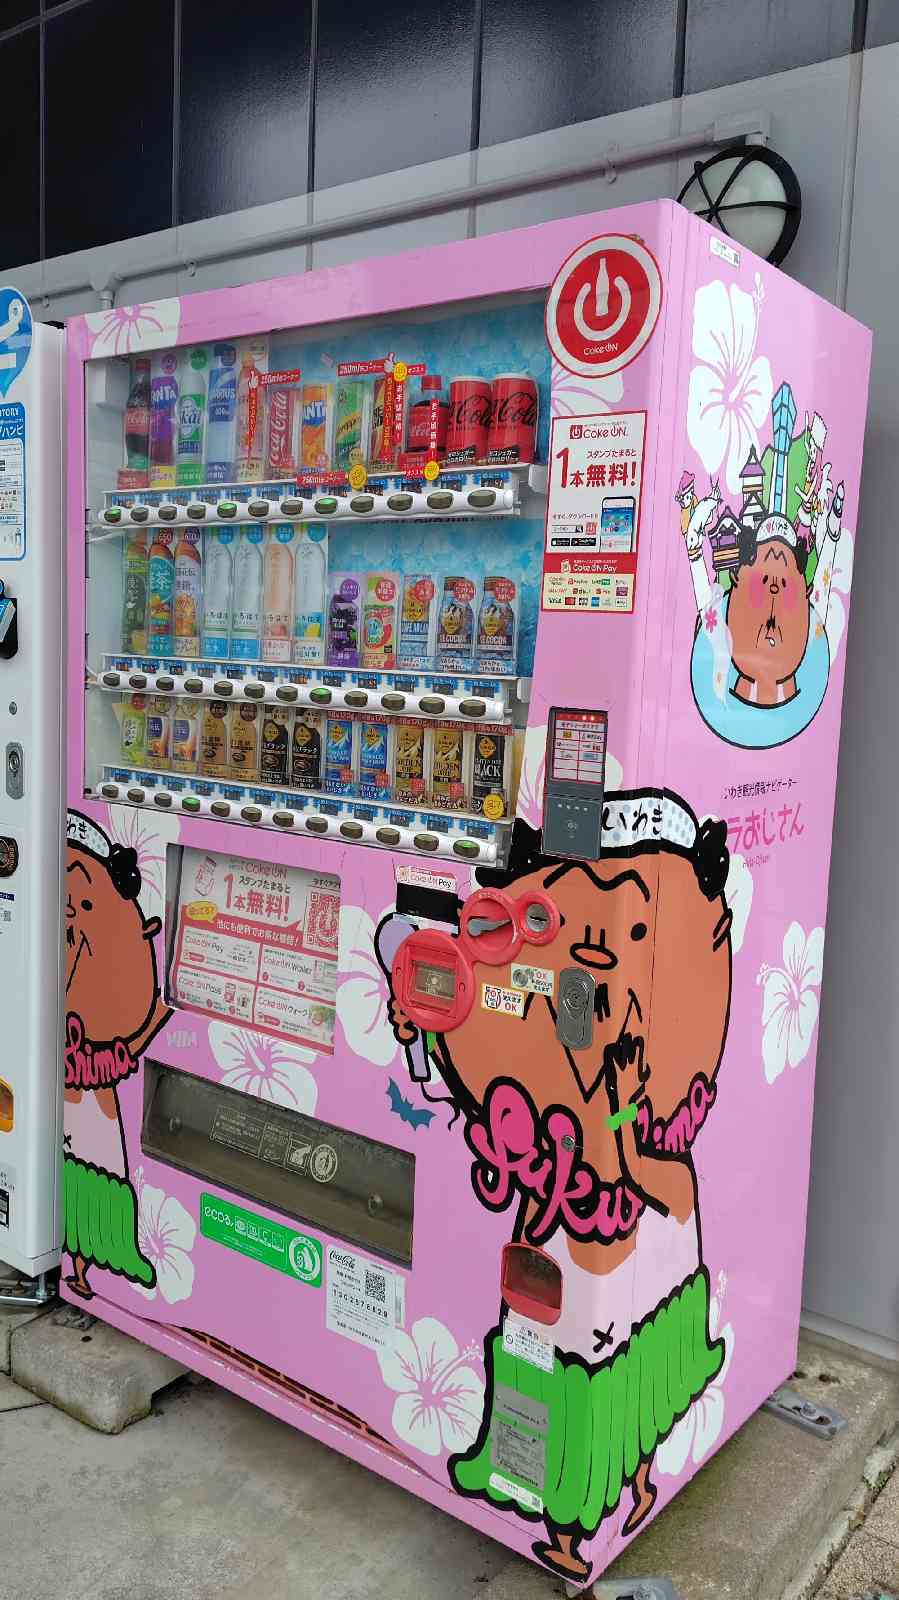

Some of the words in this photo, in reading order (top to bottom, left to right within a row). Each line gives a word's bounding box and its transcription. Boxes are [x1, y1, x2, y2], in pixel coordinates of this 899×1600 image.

[583, 428, 609, 439] Coke
[610, 425, 627, 437] ON
[586, 448, 637, 459] スタンプたまると
[556, 447, 638, 489] 1本無料!
[603, 564, 618, 575] Pay
[602, 801, 664, 837] いわき
[438, 877, 452, 889] Pay
[223, 873, 291, 922] 1本無料!
